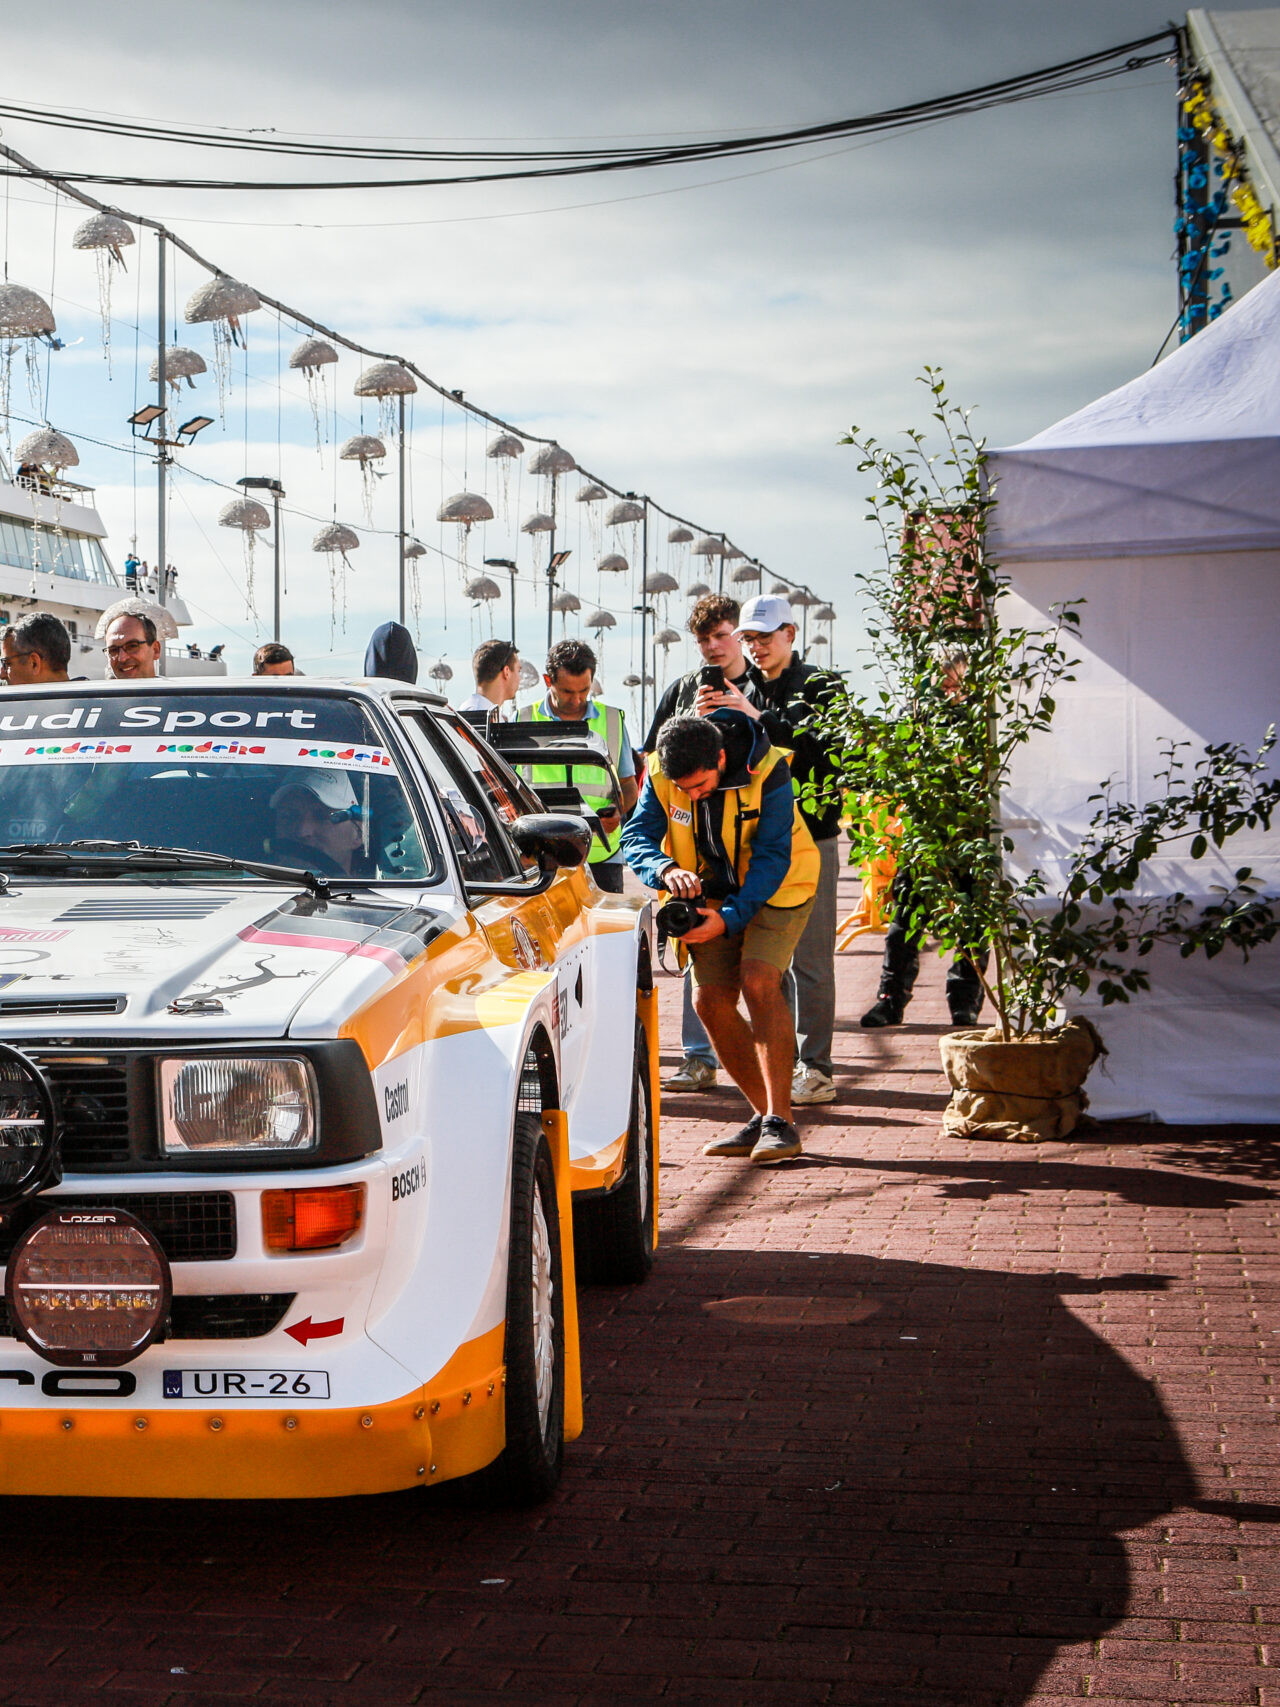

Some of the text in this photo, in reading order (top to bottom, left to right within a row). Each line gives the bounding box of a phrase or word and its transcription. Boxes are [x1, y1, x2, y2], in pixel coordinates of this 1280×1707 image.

[119, 706, 317, 732] Sport
[25, 741, 132, 755] madeira
[156, 741, 266, 755] madeira
[298, 747, 391, 766] madeir
[673, 810, 690, 823] BPI
[8, 822, 47, 837] OMP
[384, 1077, 410, 1123] Castrol
[391, 1165, 420, 1202] BOSCH
[59, 1215, 116, 1223] LAZER
[166, 1373, 311, 1395] LV UR-26
